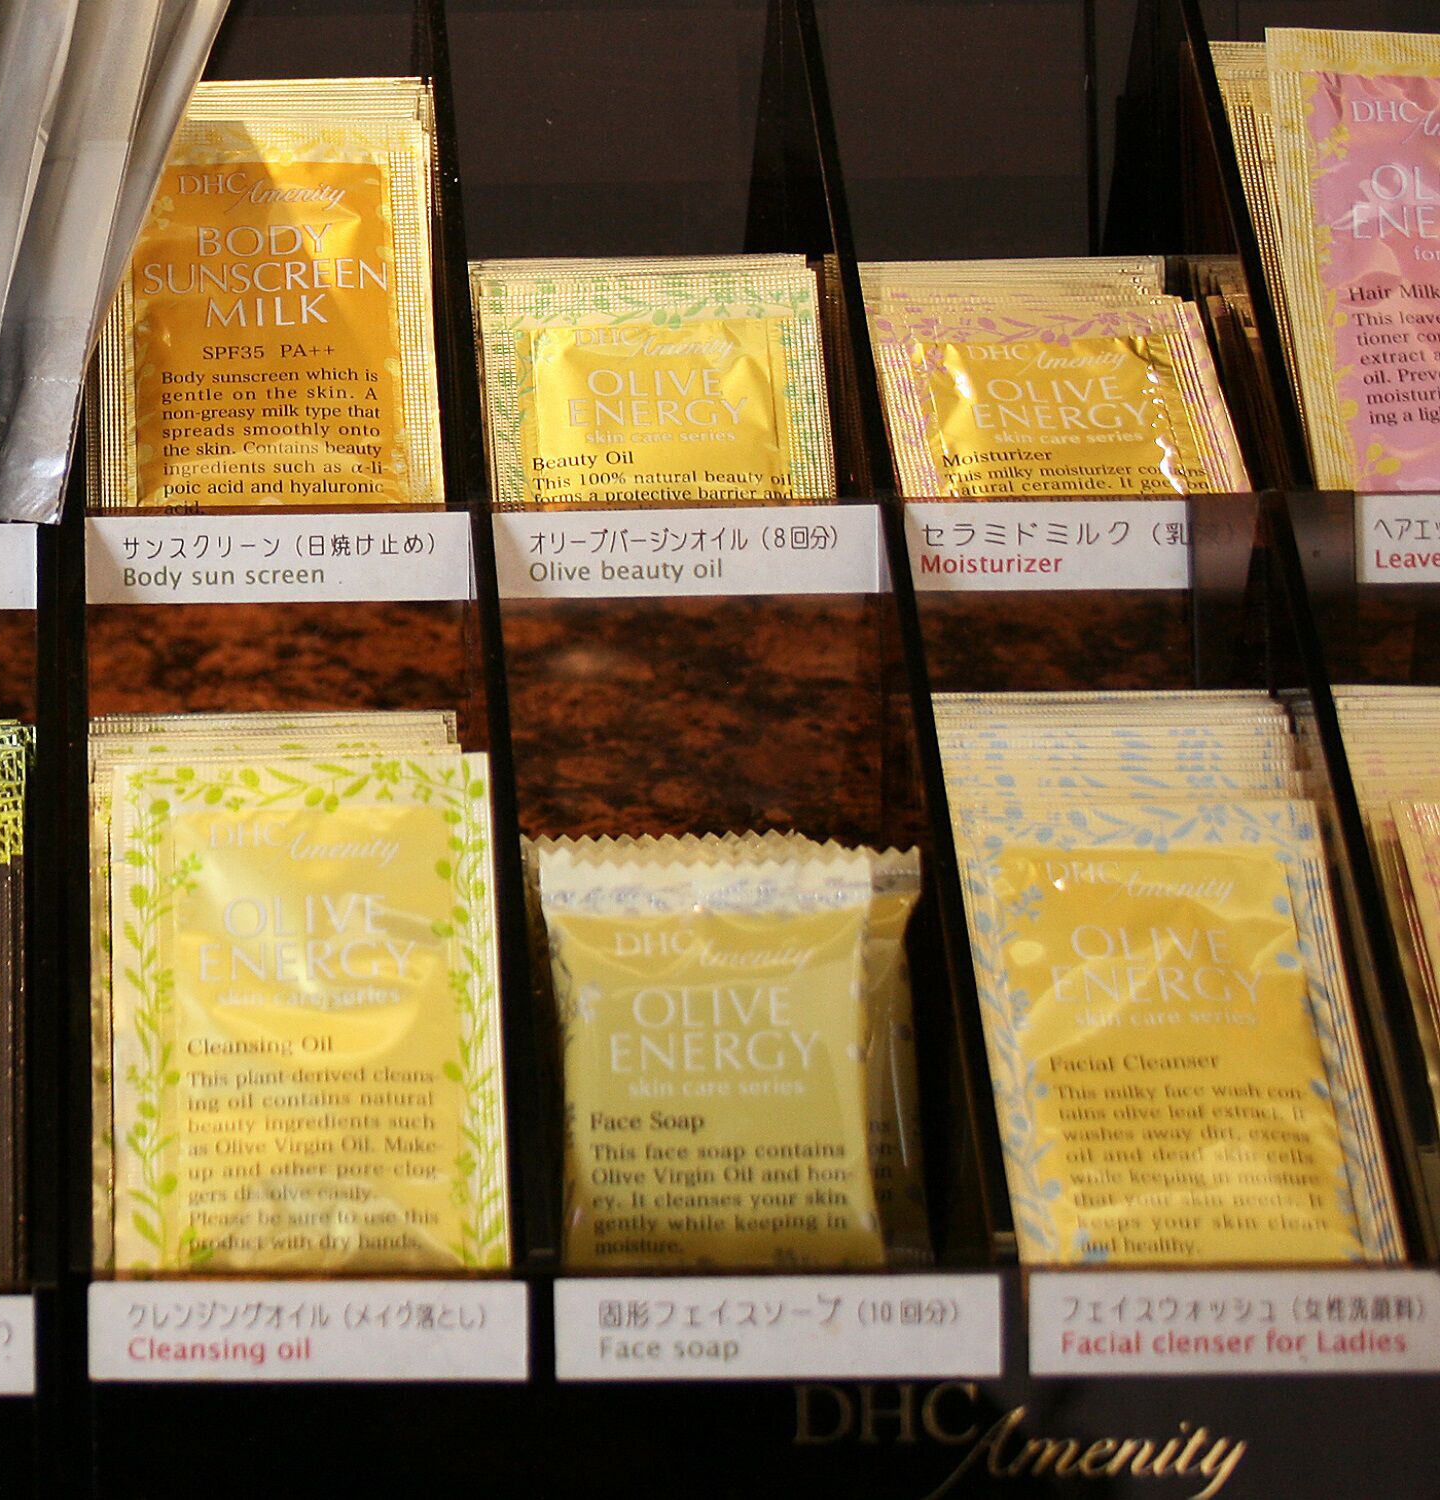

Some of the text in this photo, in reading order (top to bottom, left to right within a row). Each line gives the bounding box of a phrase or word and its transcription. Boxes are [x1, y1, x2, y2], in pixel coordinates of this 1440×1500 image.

[1352, 101, 1417, 123] DHC
[178, 173, 346, 213] DHC Amenity
[198, 224, 332, 257] BODY
[143, 259, 388, 295] SUNSCREEN
[1349, 284, 1440, 301] Hair Milk
[206, 294, 328, 328] MILK
[202, 344, 335, 360] SPF35 PA++
[1360, 353, 1425, 367] extract
[162, 368, 378, 386] Body sunscreen which is
[588, 368, 720, 397] OLIVE
[1363, 370, 1391, 385] oil.
[161, 386, 377, 404] gentle the skin. A
[987, 376, 1122, 403] OLIVE
[161, 404, 380, 421] non-greasy milk type that
[568, 398, 747, 428] ENERGY
[973, 401, 1151, 430] ENERGY
[162, 422, 380, 440] spreads smoothly onto
[586, 430, 735, 443] skin care series
[326, 442, 381, 458] beauty
[533, 451, 633, 471] Beauty Oil
[943, 449, 1052, 468] Moisturizer
[164, 461, 265, 477] ingredients
[580, 471, 763, 486] 100% natural beauty
[989, 464, 1131, 481] milky moisturizer
[164, 479, 383, 497] poic acid hyaluronic
[1022, 477, 1112, 493] ceramide.
[920, 553, 1062, 574] Moisturizer
[1376, 550, 1440, 568] Leave
[124, 567, 324, 590] Body sun screen
[530, 559, 722, 583] Olive beauty oil
[223, 894, 387, 939] OLIVE
[1071, 924, 1233, 964] OLIVE
[199, 939, 416, 983] ENERGY
[1050, 965, 1261, 1005] ENERGY
[632, 986, 792, 1028] OLIVE
[187, 1035, 332, 1057] Cleansing Oil
[610, 1030, 821, 1073] ENERGY
[1049, 1054, 1219, 1073] Facial Cleanser
[590, 1112, 704, 1134] Face Soap
[128, 1337, 311, 1364] Cleansing oil
[599, 1338, 739, 1362] Face soap
[1062, 1328, 1407, 1355] Facial clenser for Ladies
[792, 1382, 1246, 1500] DHC Amenity
